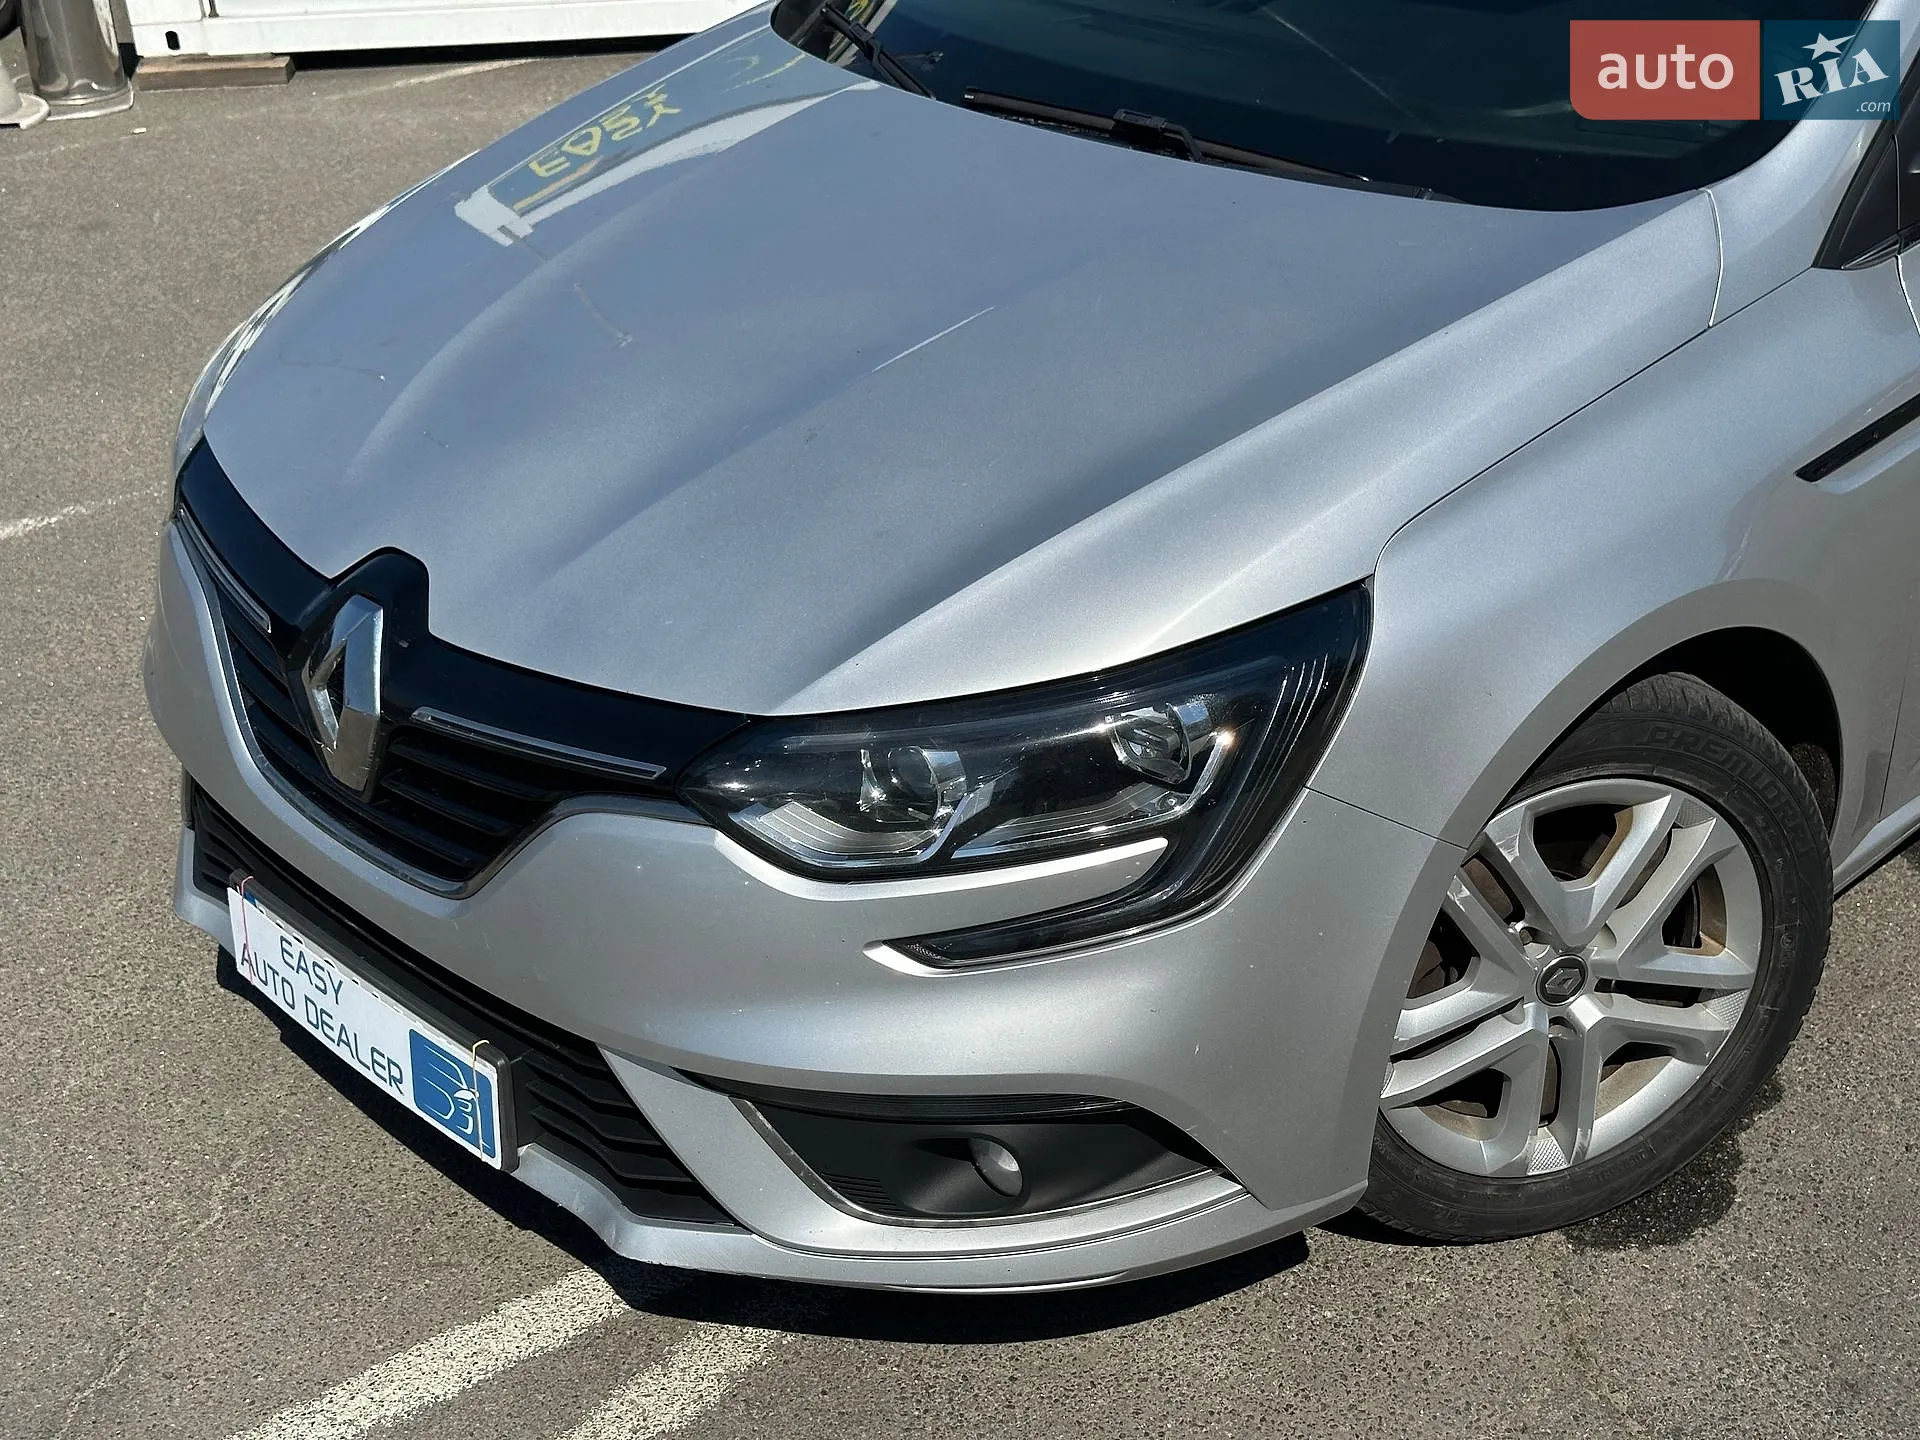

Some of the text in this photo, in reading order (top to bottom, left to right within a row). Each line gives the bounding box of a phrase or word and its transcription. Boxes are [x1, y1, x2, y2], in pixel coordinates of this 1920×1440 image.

[240, 942, 295, 1010] AUTO
[304, 993, 405, 1096] DEALER
[280, 935, 343, 1005] EASY
